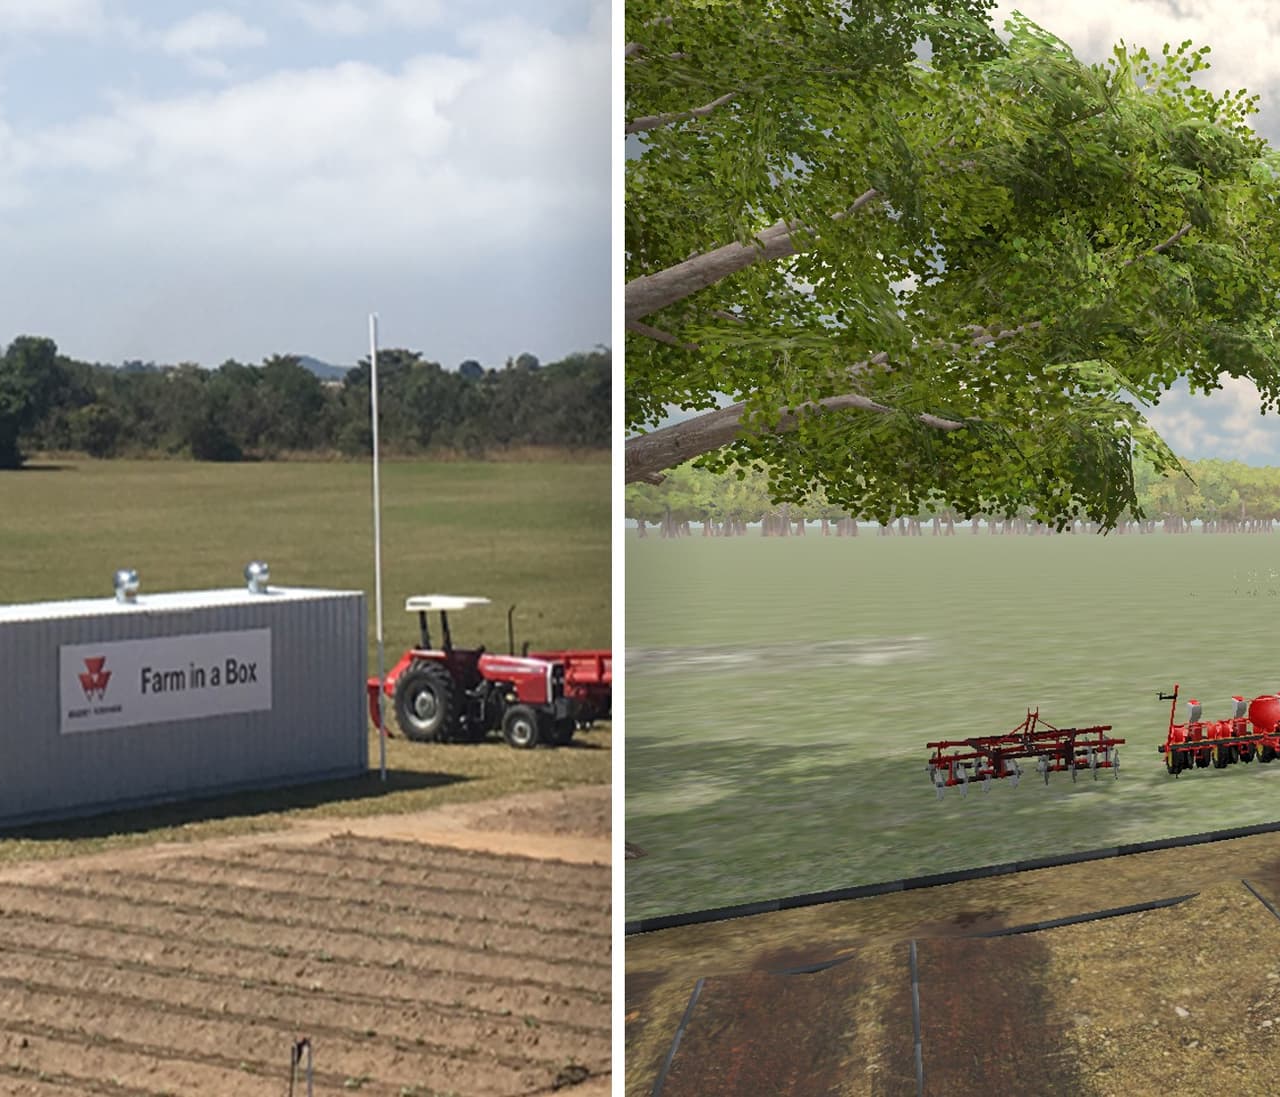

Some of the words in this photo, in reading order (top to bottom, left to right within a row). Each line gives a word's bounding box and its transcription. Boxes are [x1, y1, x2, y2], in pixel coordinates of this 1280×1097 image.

[141, 667, 186, 694] Farm
[190, 661, 205, 688] in
[210, 666, 221, 687] a
[226, 659, 257, 684] Box
